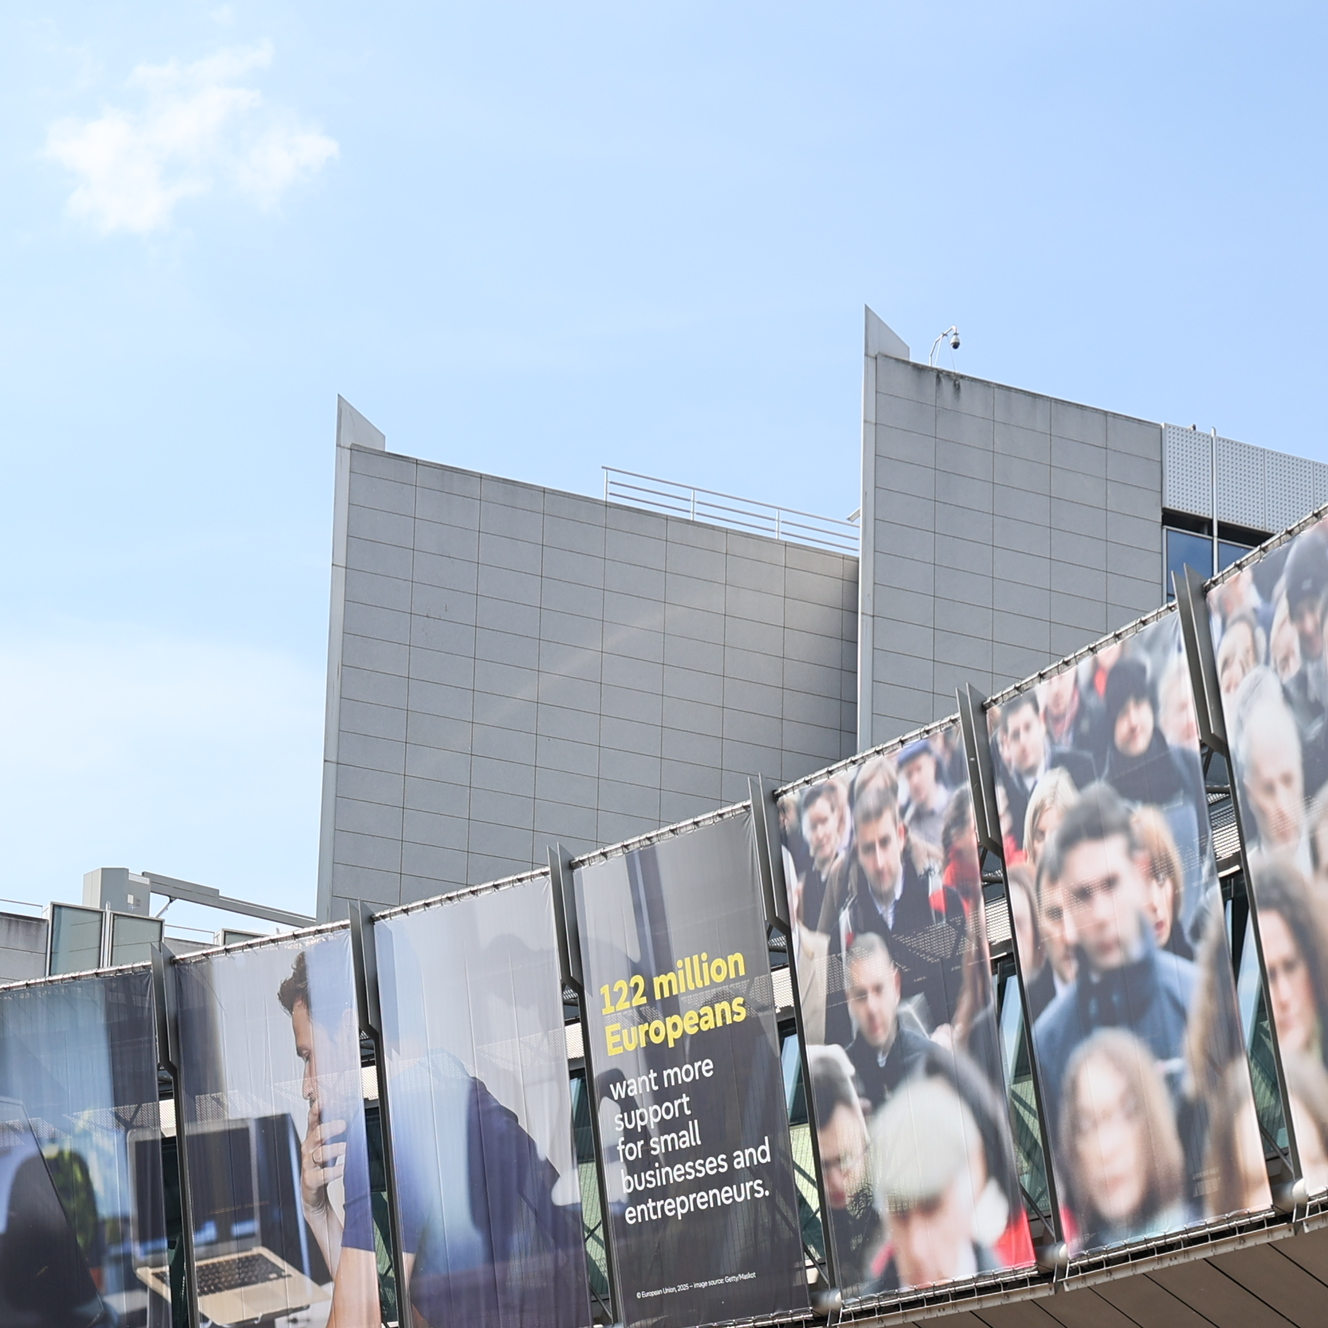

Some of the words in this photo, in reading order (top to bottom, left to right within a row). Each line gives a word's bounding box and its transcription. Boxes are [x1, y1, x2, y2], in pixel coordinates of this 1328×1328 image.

[600, 974, 647, 1015] 122
[653, 952, 746, 1001] million
[604, 997, 747, 1056] Europeans
[610, 1069, 659, 1101] want
[663, 1058, 714, 1088] more
[614, 1093, 692, 1133] support
[617, 1137, 644, 1163] for
[650, 1119, 702, 1156] small
[621, 1153, 728, 1194] businesses
[732, 1136, 771, 1170] and
[624, 1179, 770, 1225] entrepreneurs.
[641, 1289, 662, 1298] European
[693, 1281, 708, 1289] image
